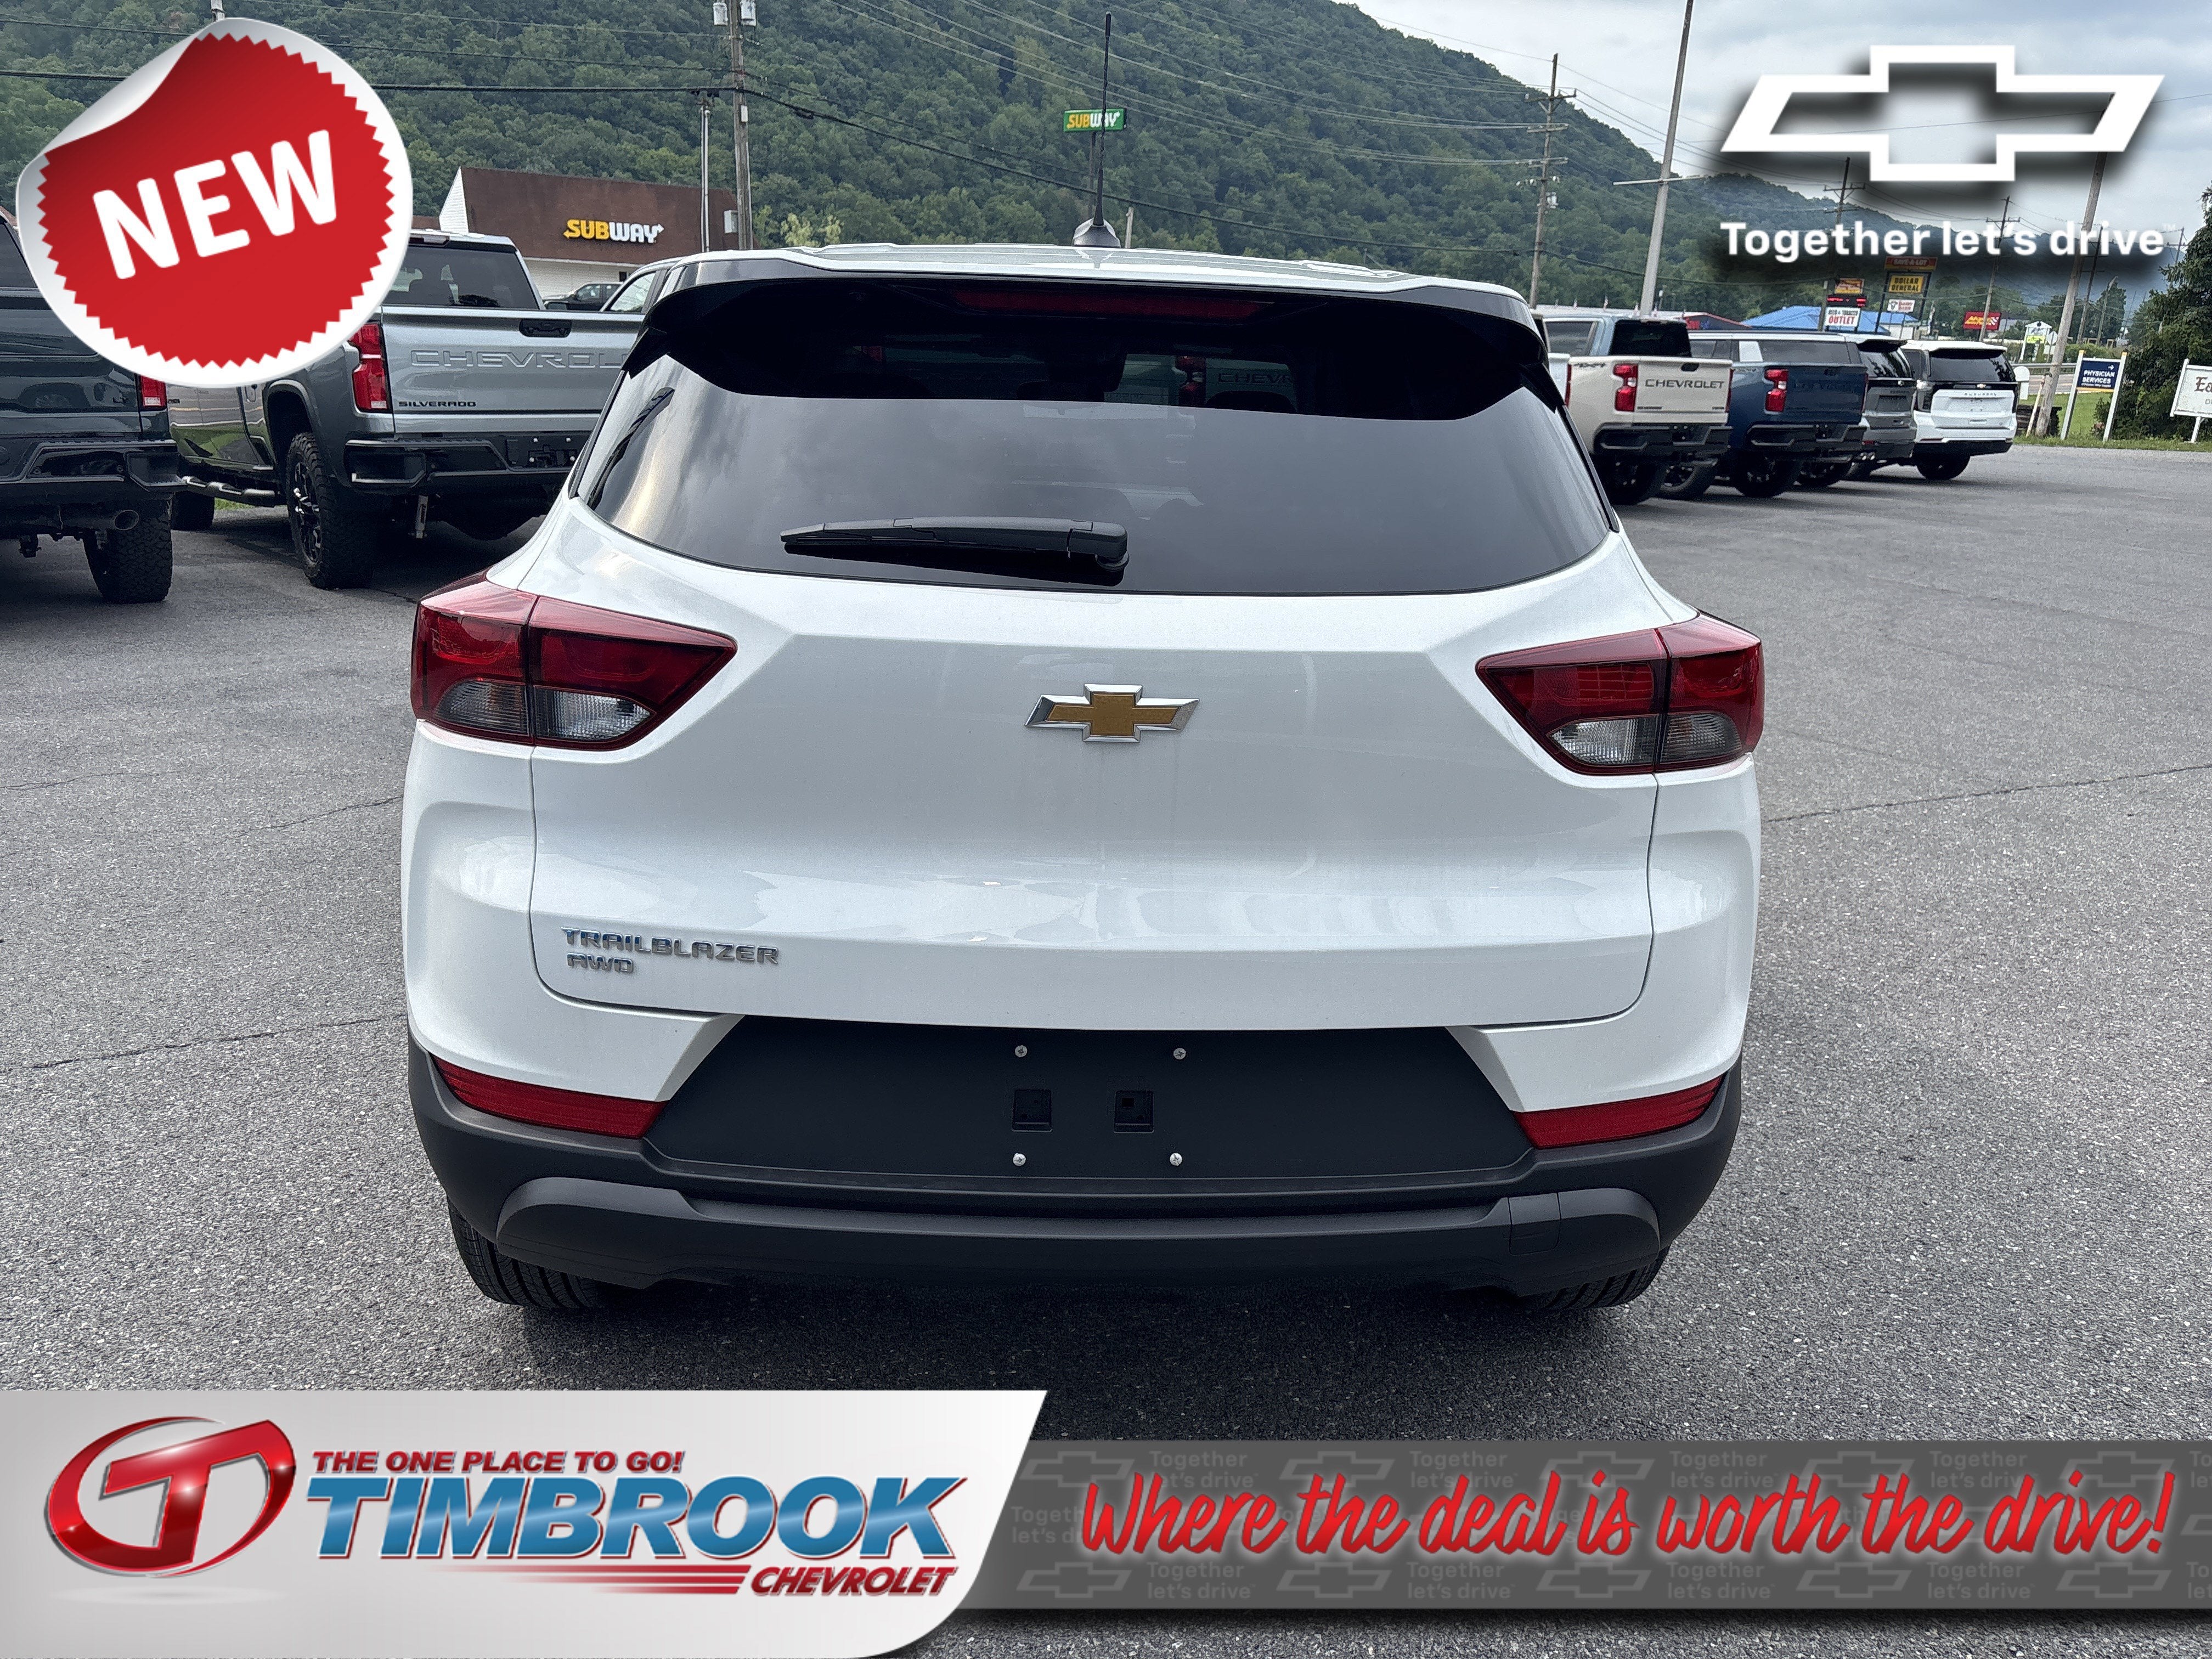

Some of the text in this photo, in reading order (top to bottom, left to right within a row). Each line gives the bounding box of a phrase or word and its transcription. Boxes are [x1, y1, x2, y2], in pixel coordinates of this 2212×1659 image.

[563, 219, 664, 243] SUBWAY
[1829, 315, 1855, 324] OUTLET
[1645, 379, 1724, 389] CHEVROLET
[560, 927, 779, 964] TRAILBLAZER
[567, 953, 634, 973] AWD
